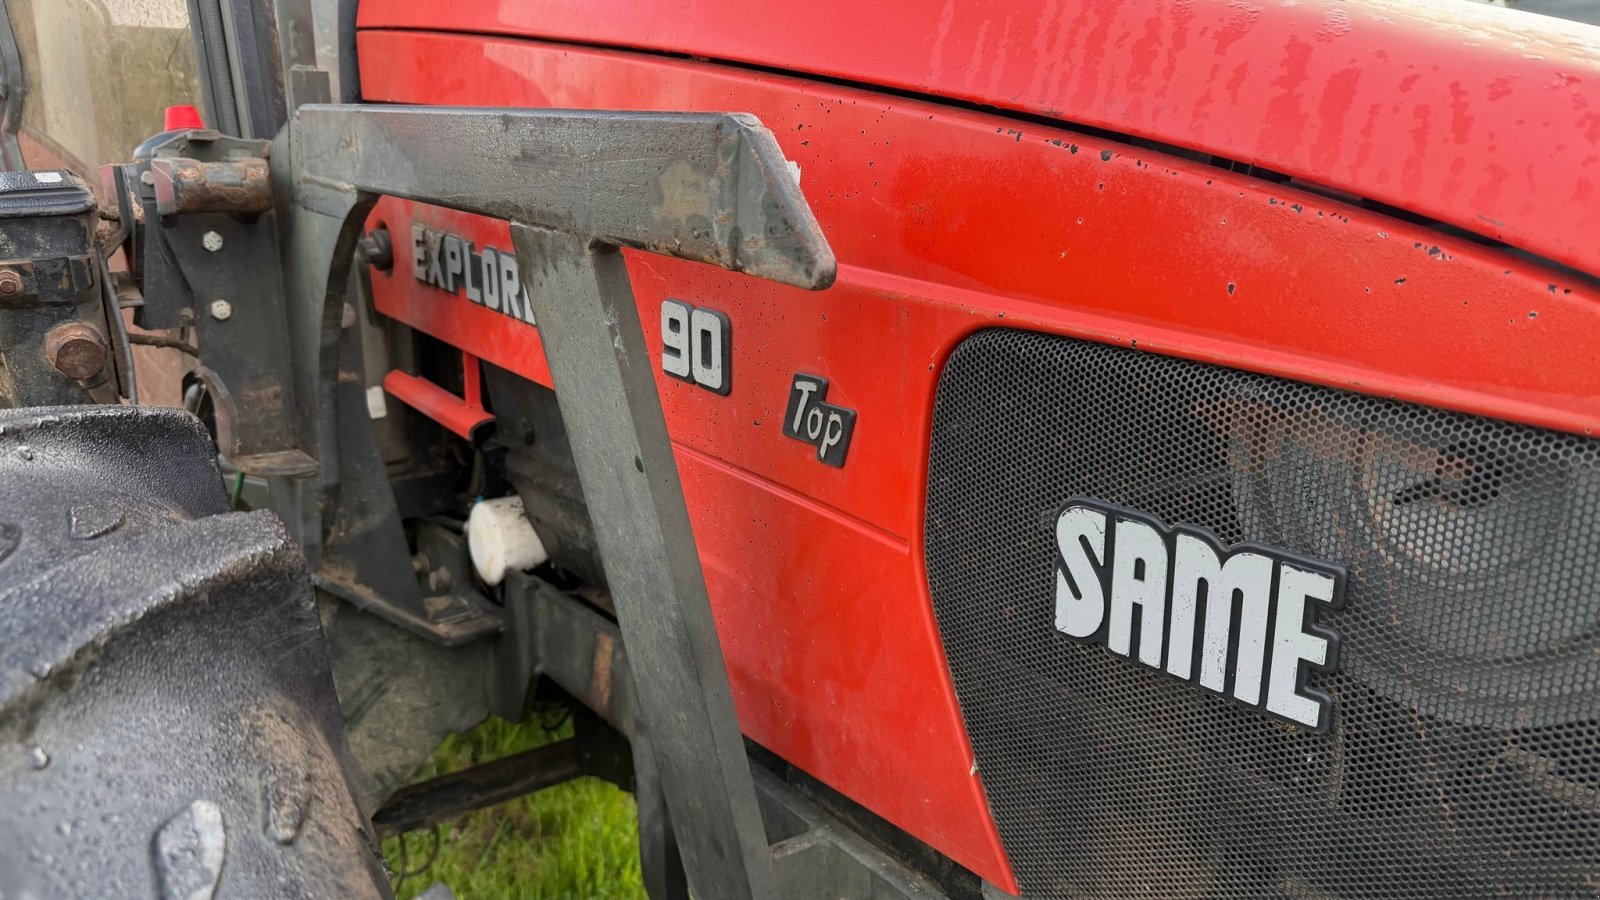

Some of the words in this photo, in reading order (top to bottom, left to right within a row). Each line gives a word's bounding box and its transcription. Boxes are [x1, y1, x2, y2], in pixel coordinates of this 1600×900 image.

[661, 299, 725, 390] 90
[792, 381, 843, 459] Top
[1054, 505, 1336, 729] SAME
